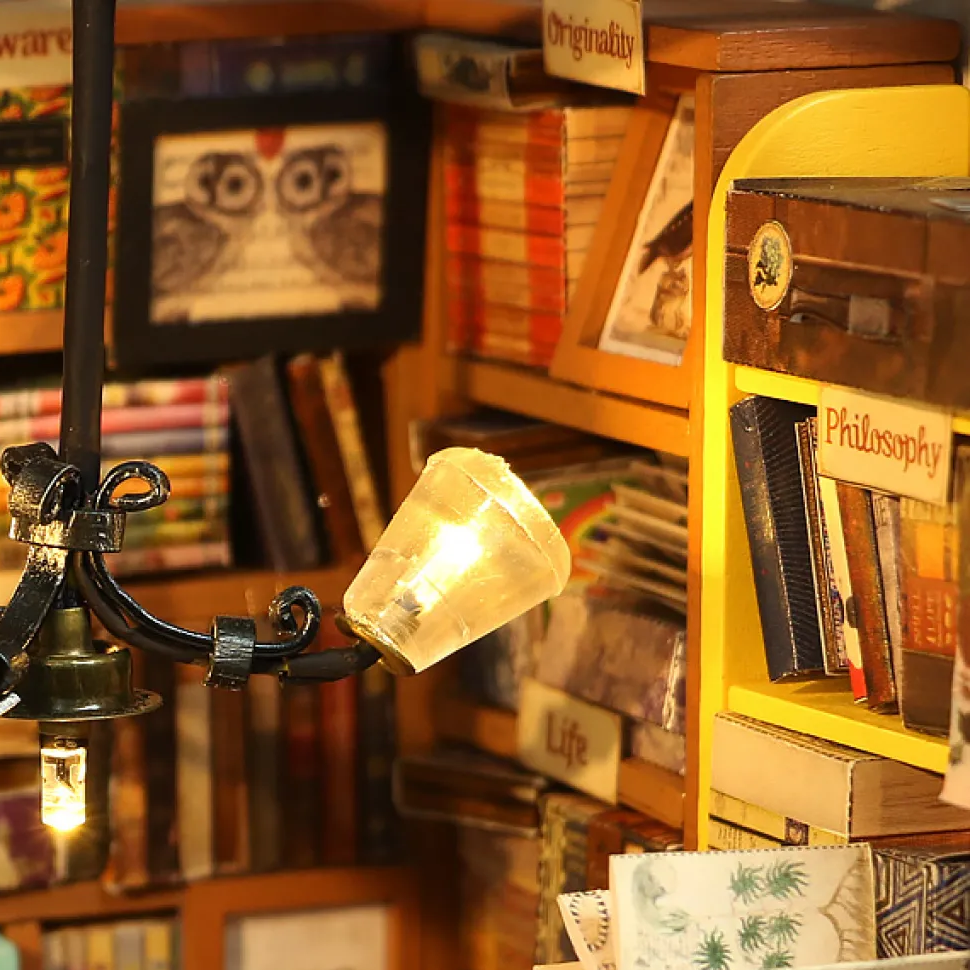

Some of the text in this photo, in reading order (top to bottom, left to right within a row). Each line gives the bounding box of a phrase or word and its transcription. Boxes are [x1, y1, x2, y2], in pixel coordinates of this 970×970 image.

[547, 11, 635, 69] Originality
[824, 407, 943, 479] Philosophy
[546, 710, 589, 768] Life
